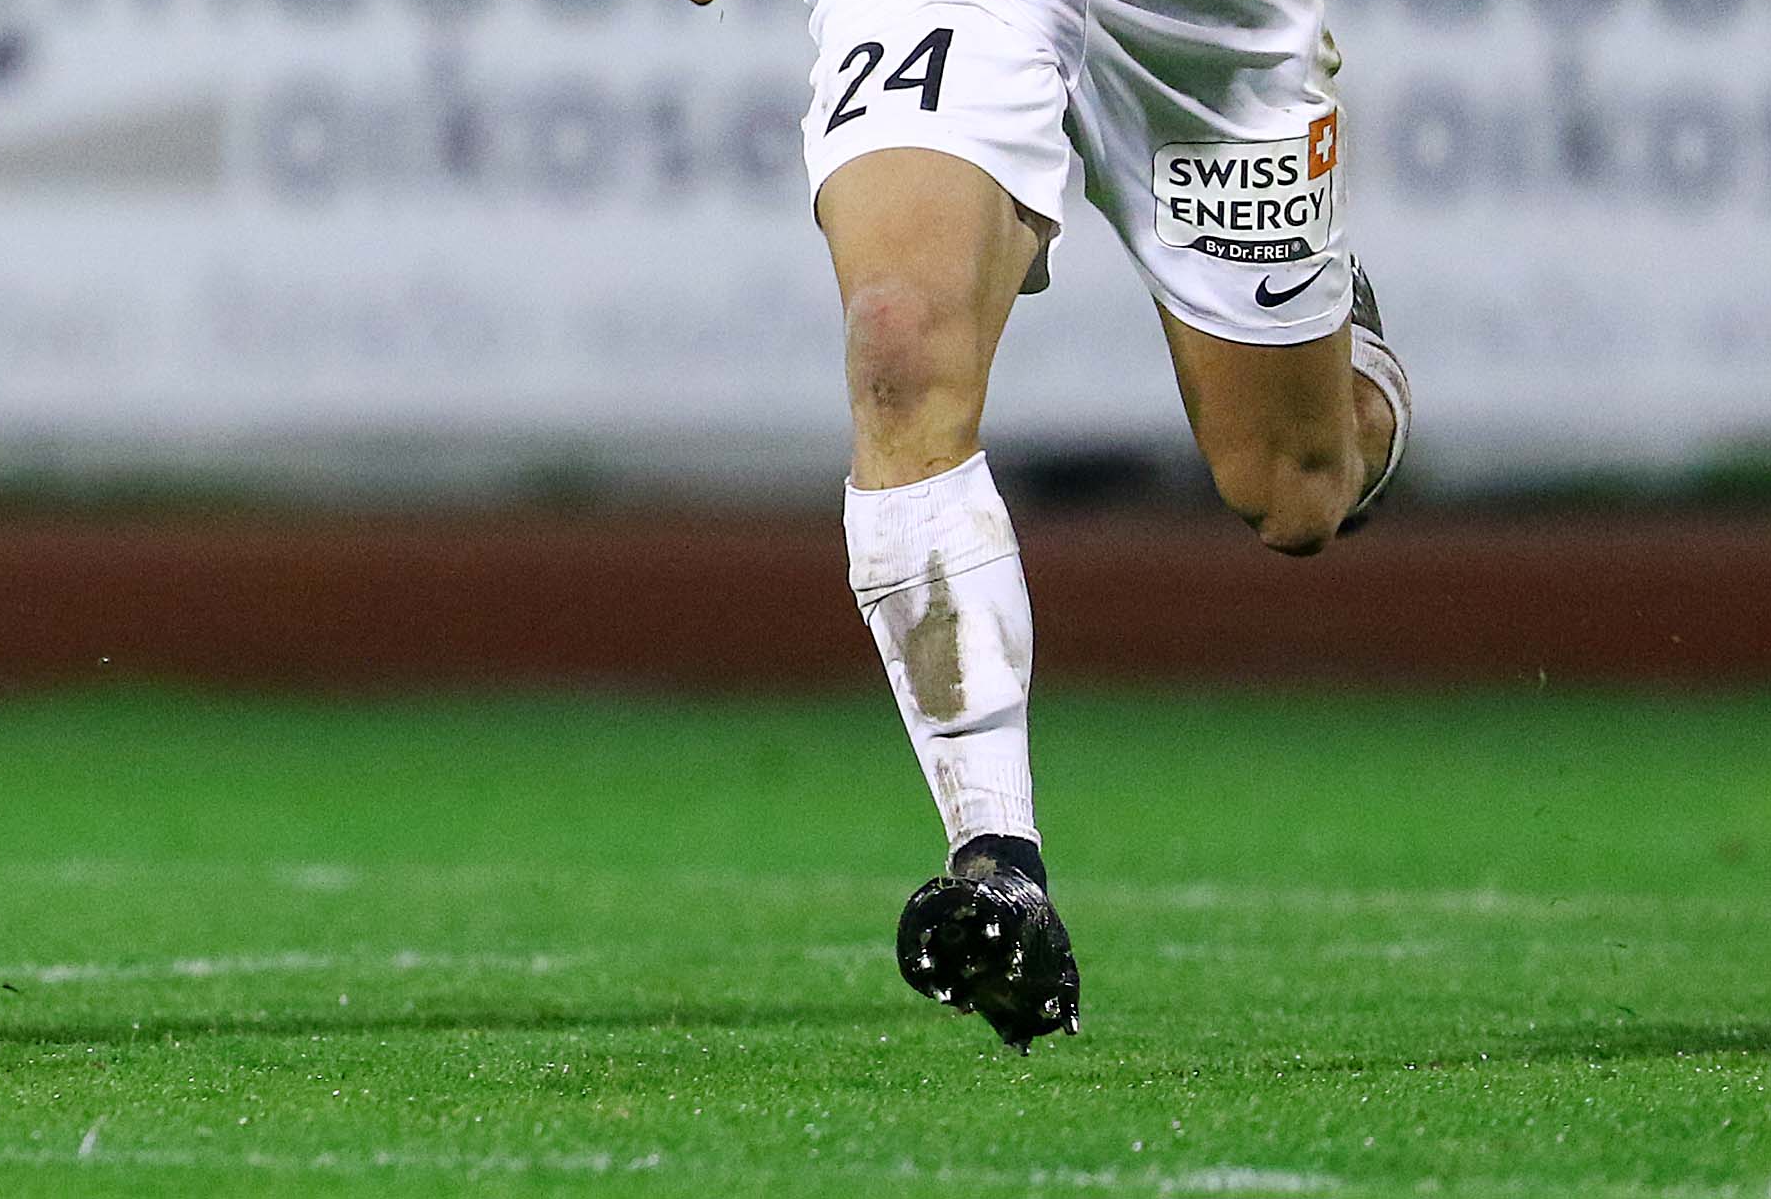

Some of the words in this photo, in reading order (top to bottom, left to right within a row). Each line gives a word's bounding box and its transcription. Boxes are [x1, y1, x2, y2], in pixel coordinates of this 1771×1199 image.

[824, 28, 954, 138] 24
[1169, 155, 1298, 189] SWISS
[1170, 187, 1325, 231] ENERGY
[1206, 240, 1226, 257] By
